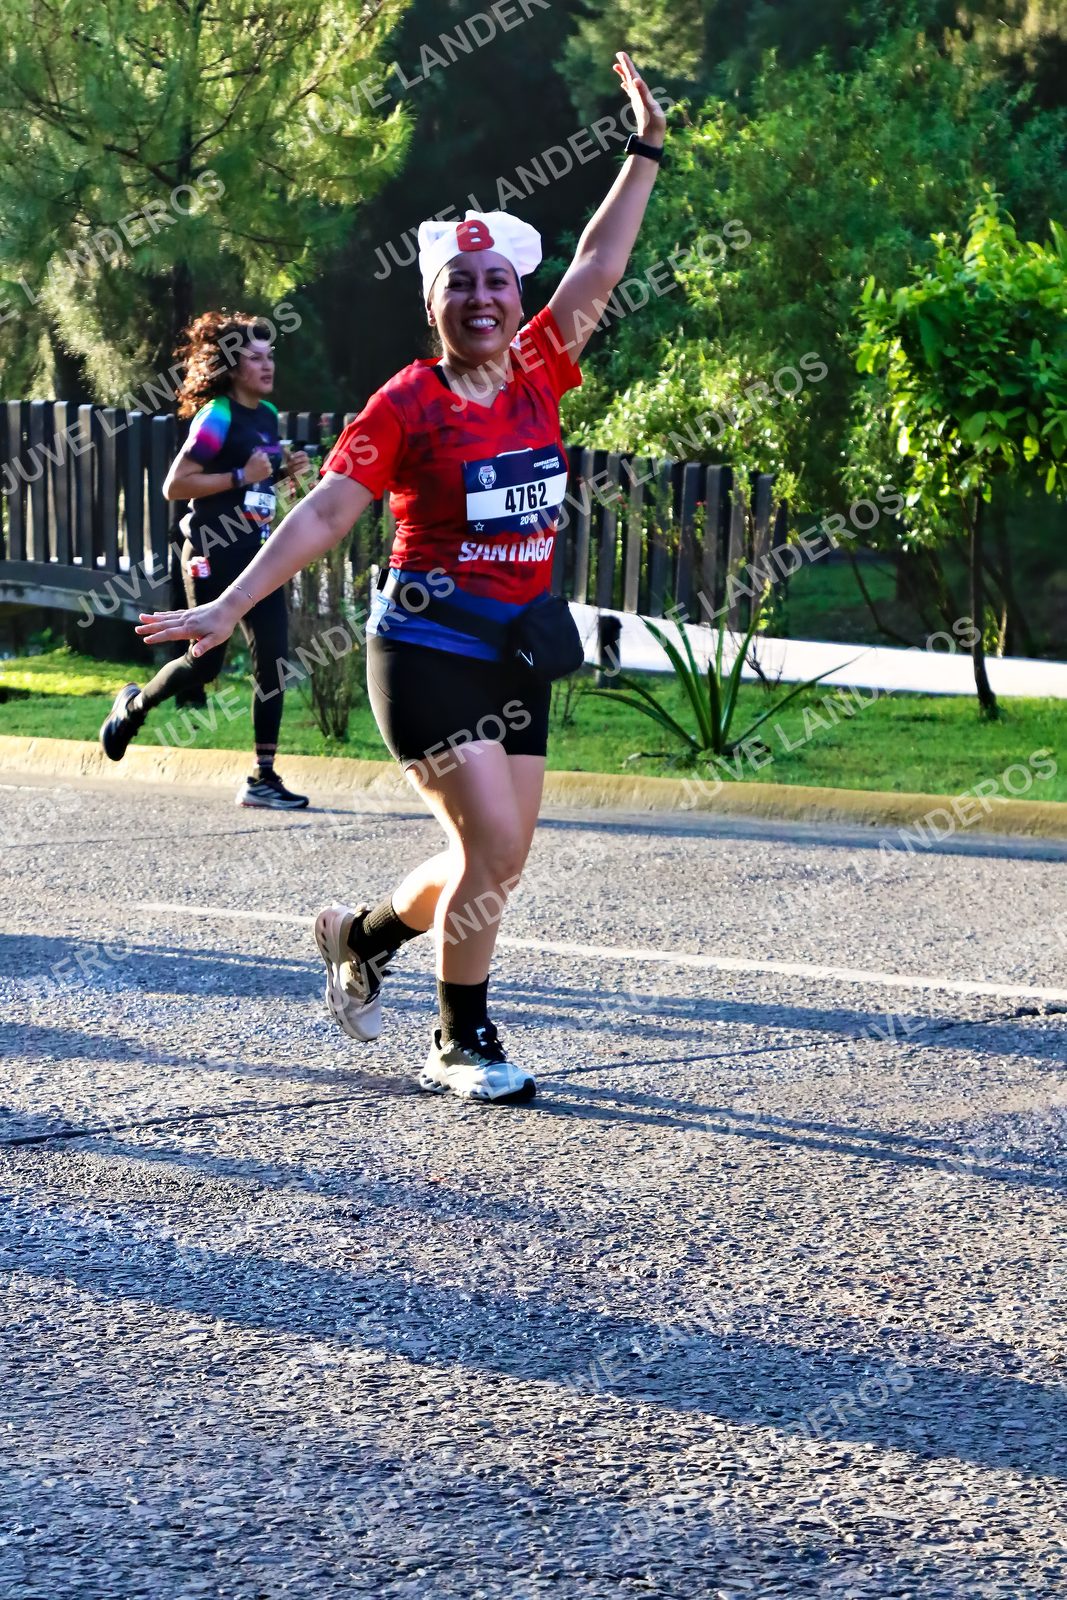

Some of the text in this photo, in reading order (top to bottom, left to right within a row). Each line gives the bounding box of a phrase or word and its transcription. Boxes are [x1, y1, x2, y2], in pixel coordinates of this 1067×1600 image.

[456, 219, 495, 251] B
[505, 481, 548, 513] 4762
[458, 536, 554, 562] SANTIAGO
